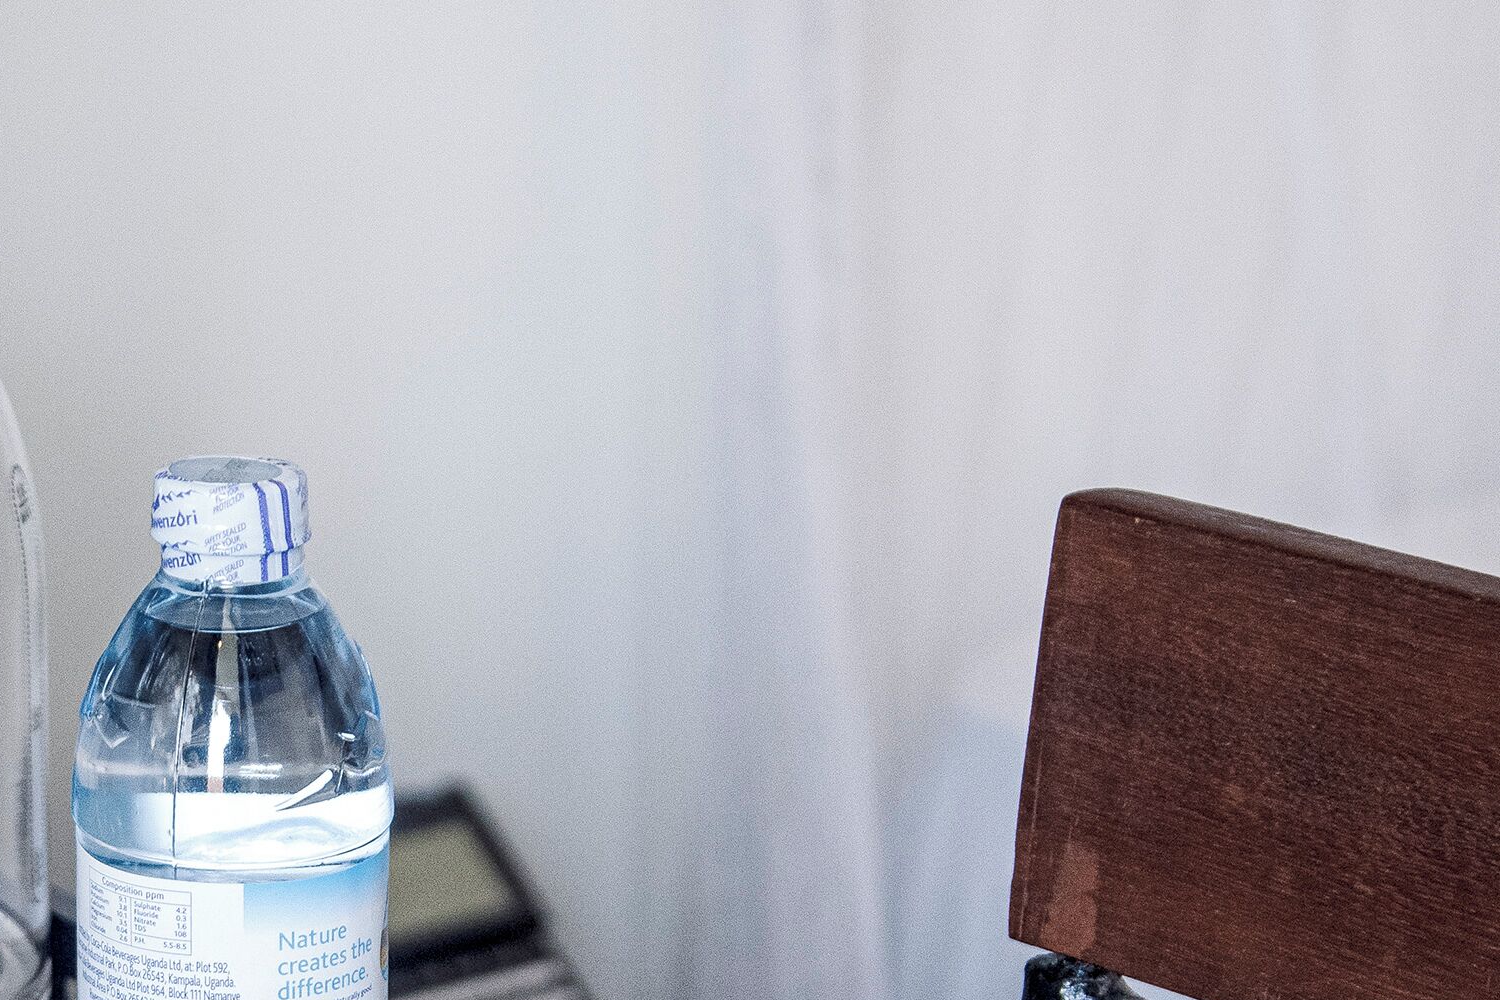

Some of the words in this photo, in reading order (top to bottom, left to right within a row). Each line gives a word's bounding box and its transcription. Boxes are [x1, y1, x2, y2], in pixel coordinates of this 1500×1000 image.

[101, 876, 143, 897] Composition
[145, 890, 165, 900] ppm
[134, 900, 161, 912] Sulphate
[175, 907, 187, 915] 4.2
[134, 908, 159, 920] Fluoride
[134, 917, 157, 927] Nitrate
[134, 924, 147, 933] TDS
[174, 930, 187, 938] 108
[163, 941, 187, 950] 5.5-8.5
[278, 924, 347, 952] Nature
[112, 945, 141, 966] Beverages
[141, 954, 168, 970] Uganda
[169, 959, 183, 973] Ltd,
[196, 961, 212, 973] Plot
[213, 962, 230, 975] 592,
[277, 949, 347, 976] creates
[351, 937, 373, 960] the
[142, 968, 167, 985] 26543,
[168, 973, 203, 990] Kampala,
[204, 975, 236, 990] Uganda.
[277, 966, 370, 1000] difference.
[137, 981, 150, 994] Plot
[150, 984, 167, 999] 964,
[168, 987, 189, 1000] Block
[190, 989, 202, 1000] 111
